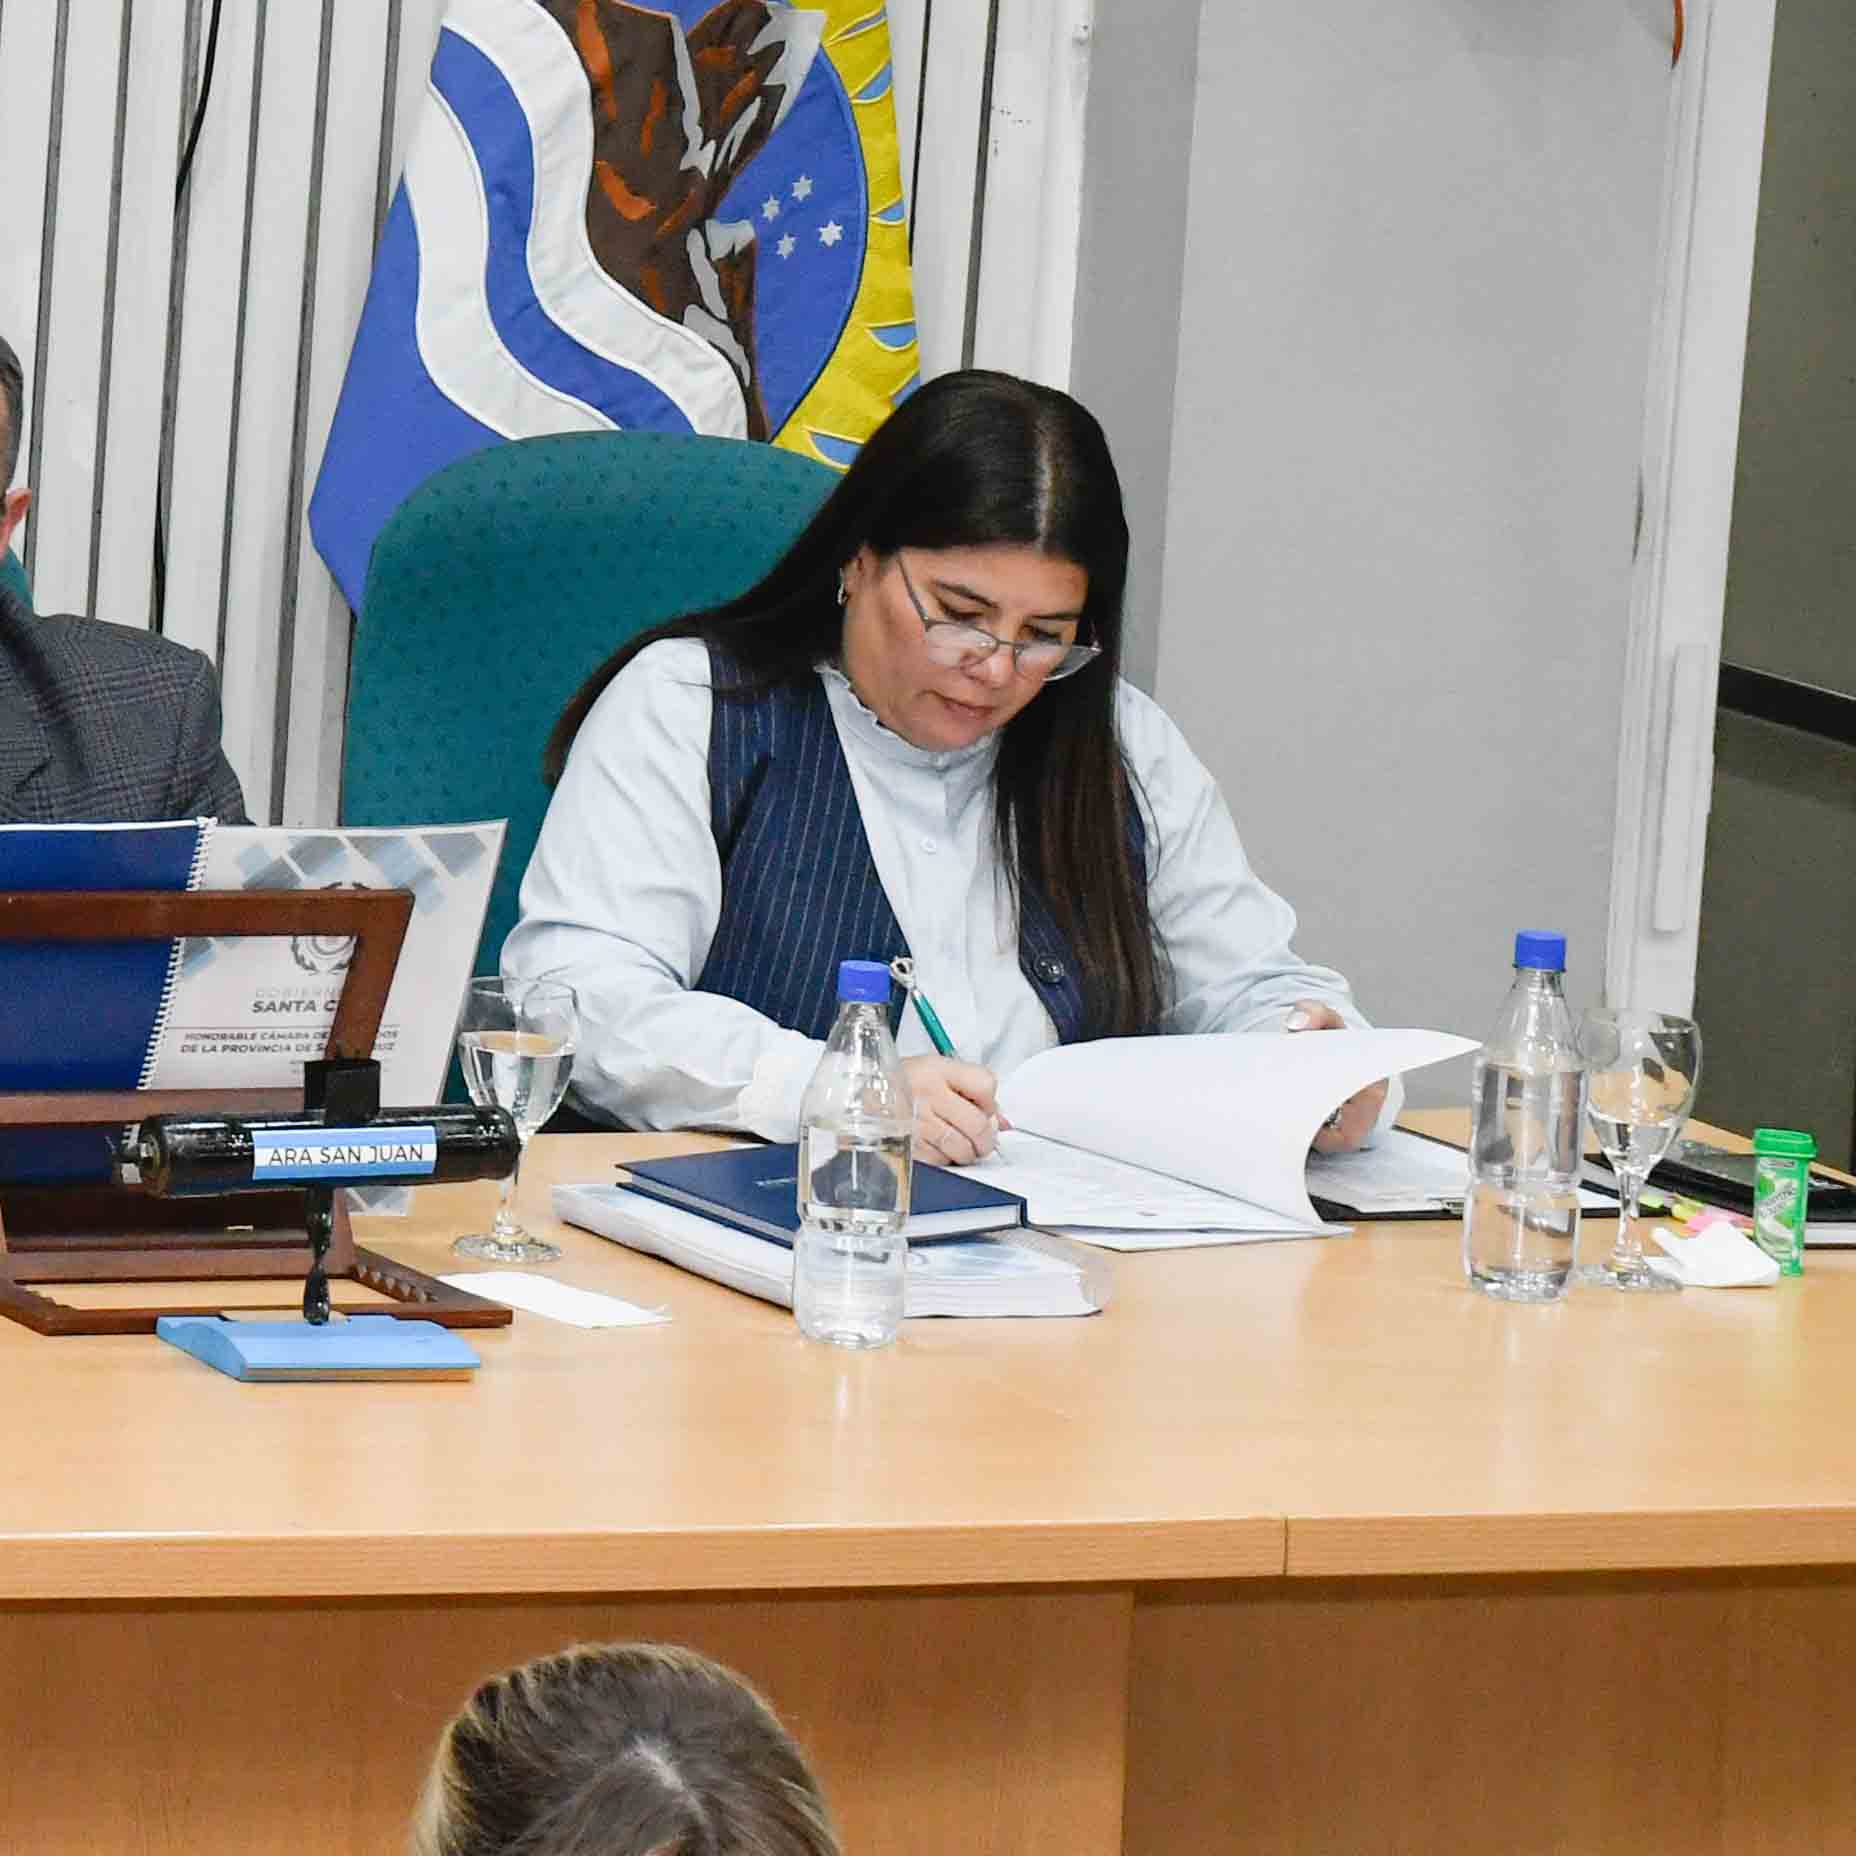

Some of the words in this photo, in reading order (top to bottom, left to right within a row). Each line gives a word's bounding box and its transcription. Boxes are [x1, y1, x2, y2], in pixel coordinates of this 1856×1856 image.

[251, 999, 318, 1014] SANTA
[184, 1031, 257, 1041] HONORABLE
[180, 1044, 198, 1054] DE
[201, 1044, 218, 1053] LA
[220, 1043, 292, 1053] PROVINCIA
[268, 1147, 313, 1166] ARA
[319, 1145, 362, 1164] SAN
[368, 1144, 424, 1164] JUAN
